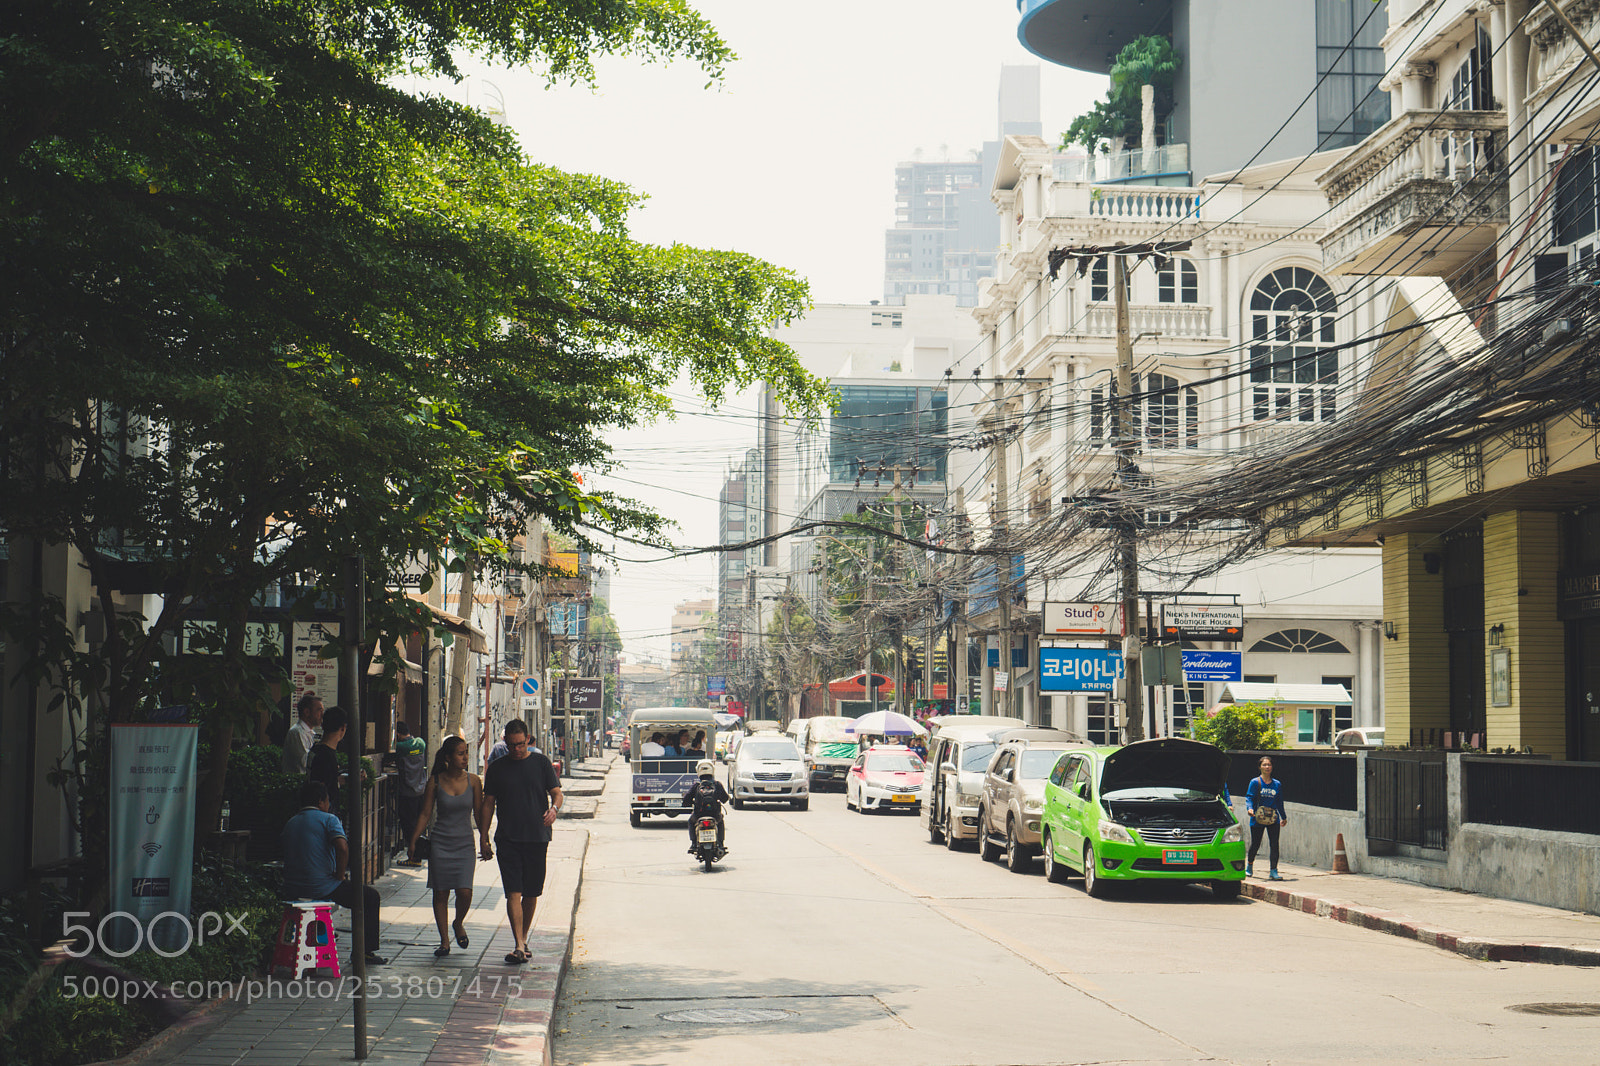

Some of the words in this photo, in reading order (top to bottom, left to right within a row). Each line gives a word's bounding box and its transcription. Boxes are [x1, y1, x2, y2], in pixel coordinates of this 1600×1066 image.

[1064, 605, 1105, 622] Studio
[1191, 611, 1240, 619] INTERNATIONAL
[1210, 618, 1232, 626] HOUSE
[1042, 658, 1122, 681] 코리아나
